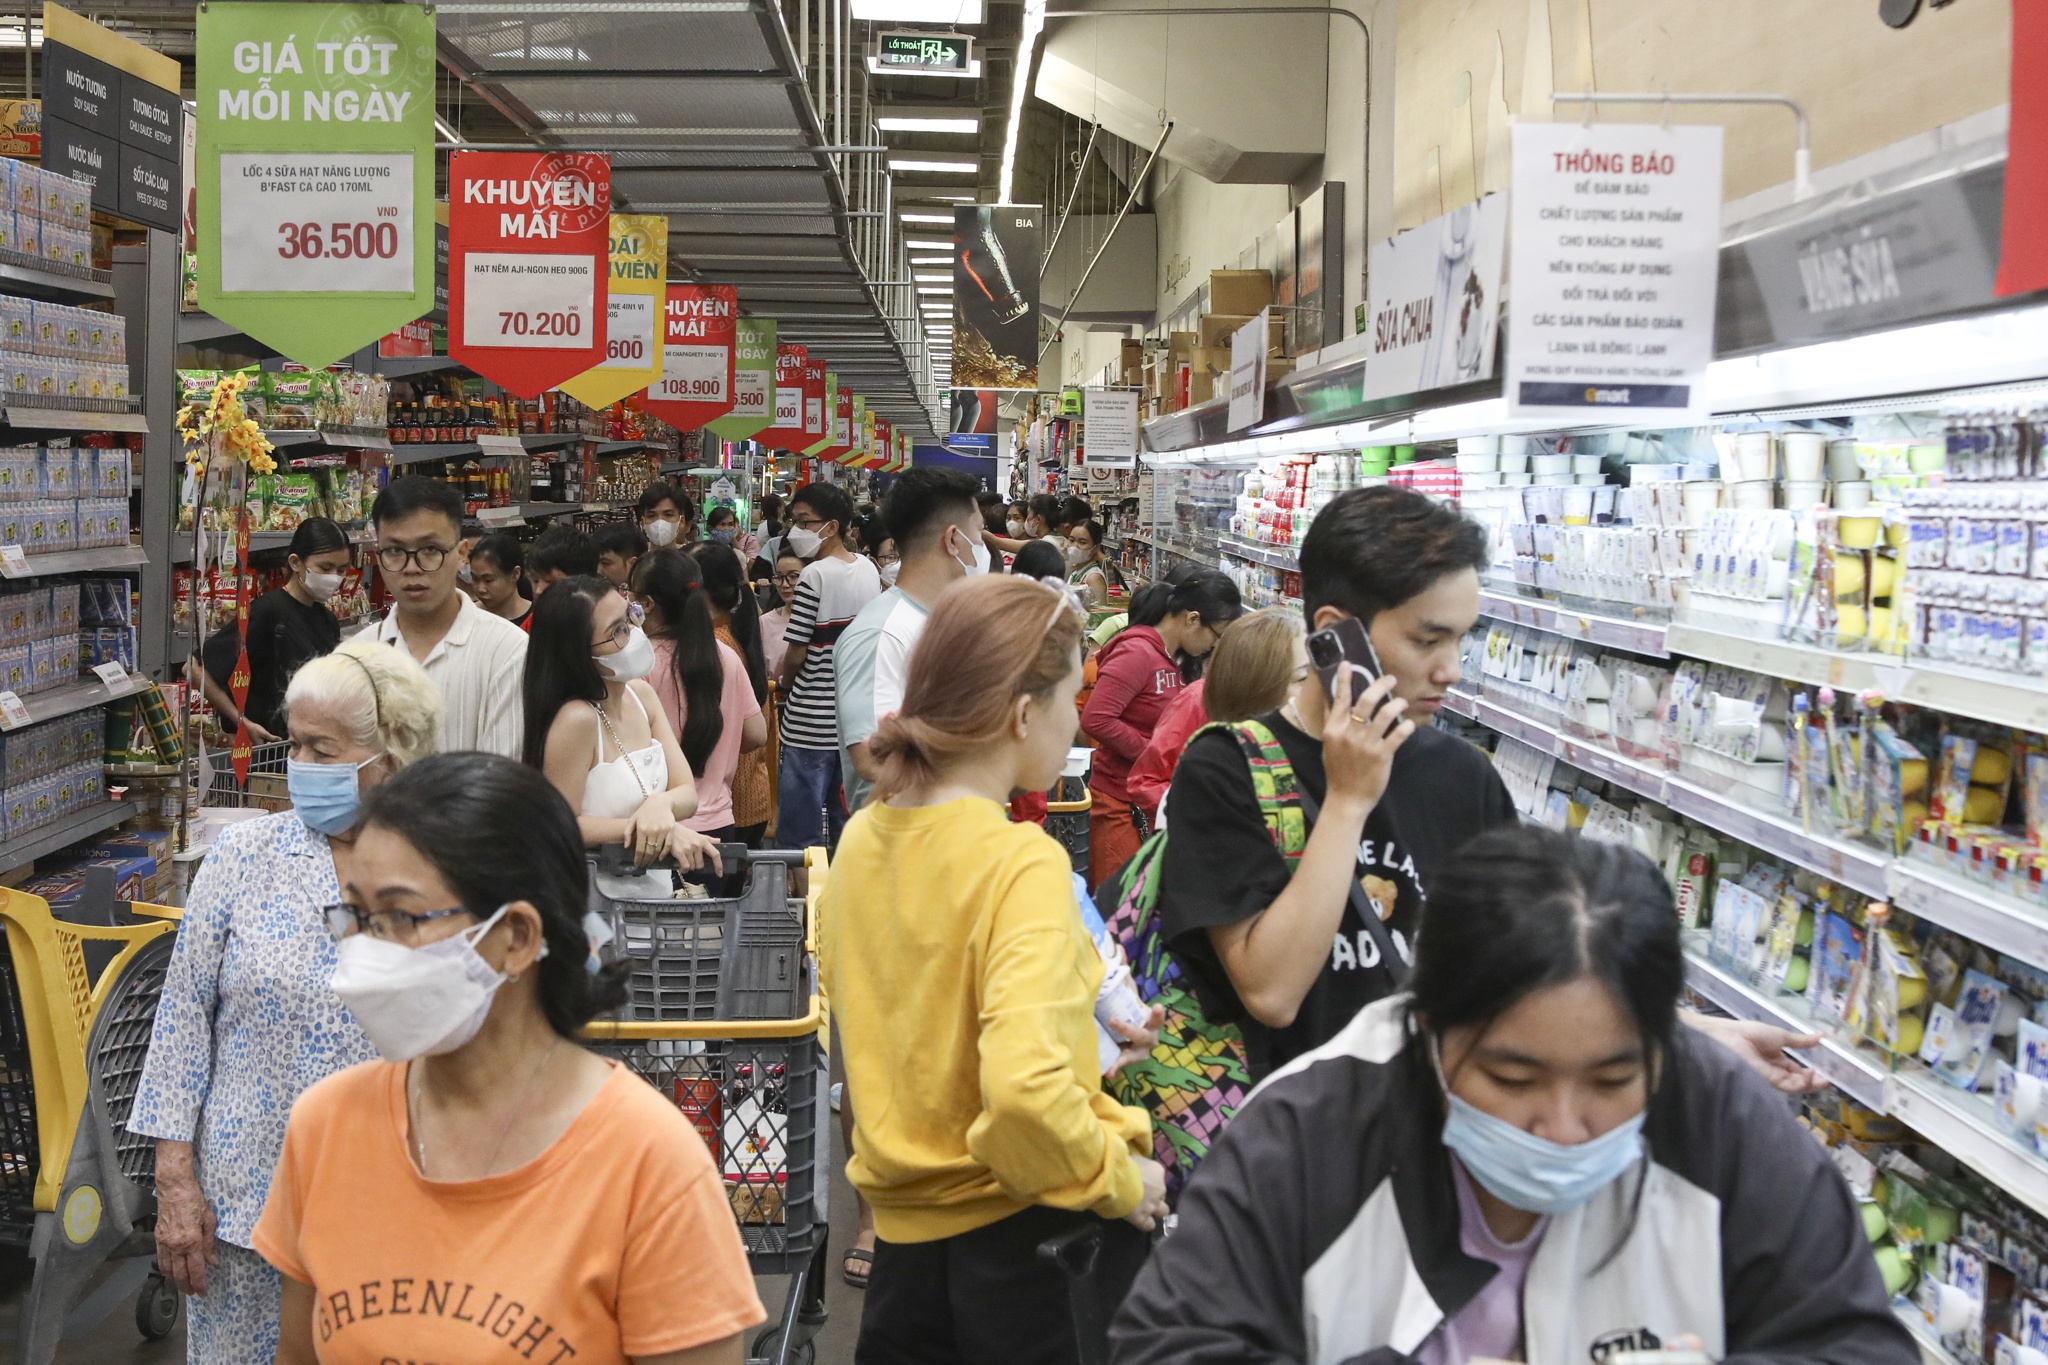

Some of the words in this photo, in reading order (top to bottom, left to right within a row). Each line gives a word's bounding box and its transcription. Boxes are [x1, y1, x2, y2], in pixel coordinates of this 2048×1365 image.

[234, 34, 303, 74] GIÁ
[317, 35, 397, 74] TỐT
[889, 40, 900, 49] LỐI
[901, 41, 921, 50] THOÁT
[891, 54, 917, 63] EXIT
[66, 69, 85, 92] NƯỚC
[86, 78, 107, 99] TƯƠNG
[73, 97, 83, 110] SOY
[84, 101, 98, 116] SAUCE
[132, 98, 152, 117] TƯƠNG
[219, 77, 290, 121] MỖI
[304, 84, 411, 122] NGÀY
[129, 119, 140, 134] CHILI
[140, 123, 153, 138] SAUCE
[154, 128, 171, 144] KETCHUP
[68, 144, 86, 164] NƯỚC
[87, 148, 102, 169] MẮM
[1553, 148, 1624, 174] THÔNG
[1630, 150, 1675, 175] BÁO
[72, 169, 83, 182] FISH
[83, 172, 97, 187] SAUCE
[133, 165, 144, 184] SỐT
[145, 171, 156, 188] CÁC
[156, 175, 169, 194] LOẠI
[243, 163, 262, 177] LỐC
[265, 167, 272, 177] 4
[275, 164, 296, 177] SỮA
[300, 167, 319, 180] HẠT
[322, 164, 351, 177] NĂNG
[354, 166, 390, 180] LƯỢNG
[260, 181, 296, 192] B'FAST
[299, 181, 313, 192] CA
[316, 182, 337, 192] CAO
[340, 182, 373, 192] 170ML
[464, 175, 595, 206] KHUYẾN
[152, 196, 168, 211] SAUCES
[377, 206, 398, 217] VND
[500, 208, 557, 239] MÃI
[1015, 218, 1034, 228] BIA
[1539, 204, 1570, 221] CHẤT
[1574, 207, 1616, 224] LƯỢNG
[278, 222, 398, 259] 36.500
[1559, 235, 1583, 247] CHO
[1587, 233, 1626, 248] KHÁCH
[1630, 234, 1664, 249] HÀNG
[474, 264, 490, 276] HẠT
[491, 263, 510, 274] NÊM
[511, 265, 549, 275] AJI-NGON
[550, 266, 566, 275] HEO
[568, 266, 588, 275] 900G
[615, 259, 658, 279] VIÊN
[1577, 258, 1617, 275] KHÔNG
[607, 303, 621, 311] UNE
[622, 303, 636, 311] 4IN1
[664, 297, 729, 317] HUYẾN
[498, 312, 581, 336] 70.200
[669, 318, 706, 337] MÃI
[1401, 295, 1433, 347] CHUA
[736, 329, 764, 344] TỐT
[607, 340, 643, 359] 600
[661, 379, 720, 395] 108.900
[1155, 669, 1176, 695] FIT
[318, 1278, 576, 1365] GREENLIGHT
